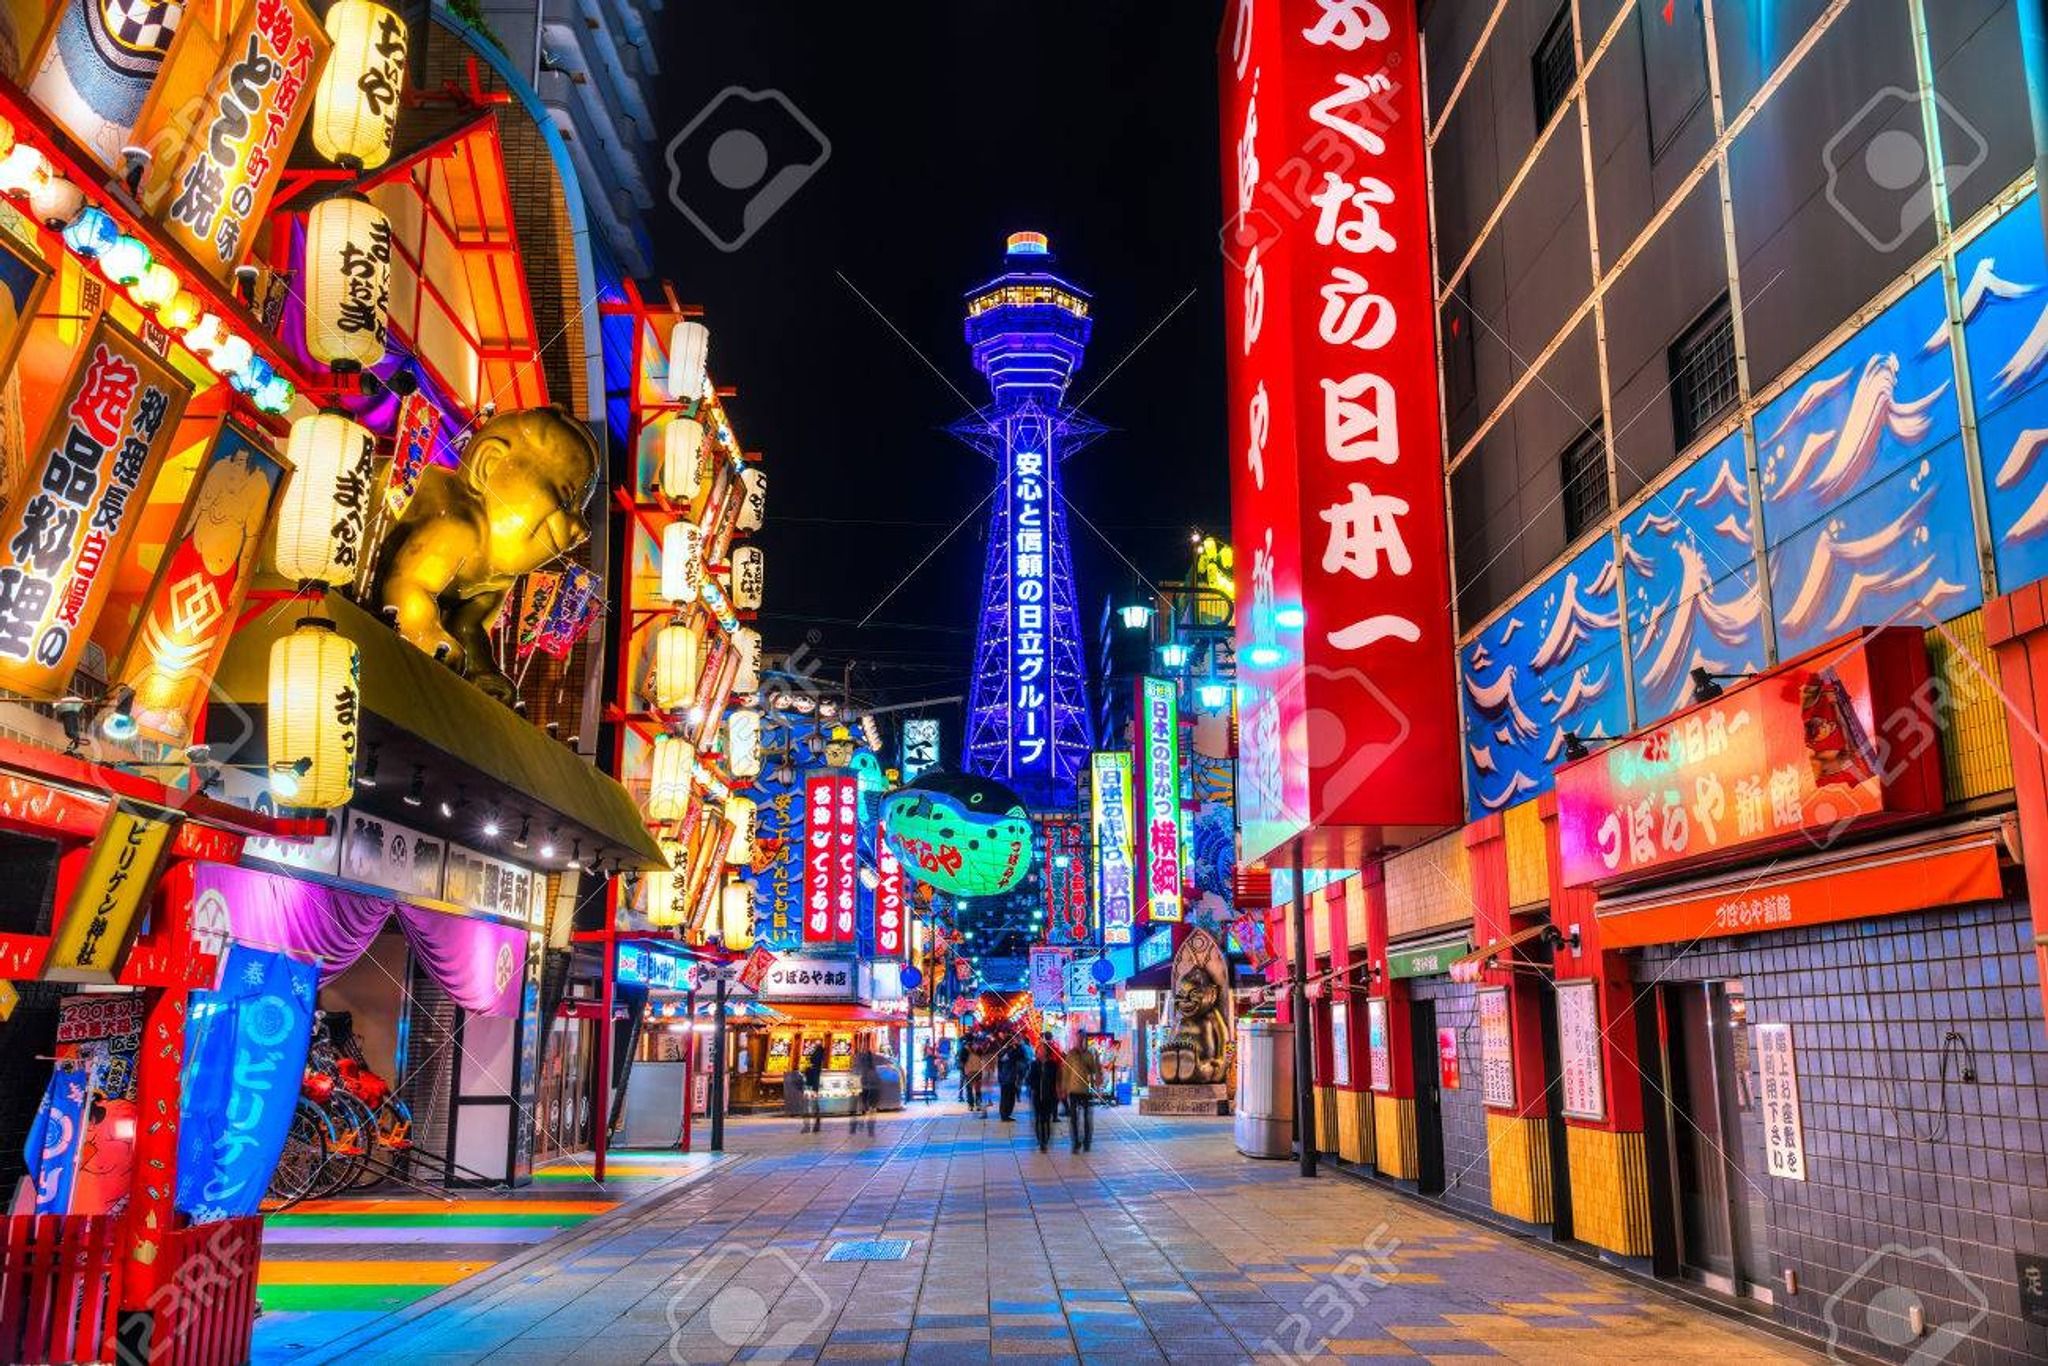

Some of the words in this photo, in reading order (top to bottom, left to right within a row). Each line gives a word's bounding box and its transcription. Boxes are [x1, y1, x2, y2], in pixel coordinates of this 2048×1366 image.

[217, 37, 314, 262] 大阪下町の味
[0, 343, 140, 660] 逸品料理
[36, 384, 168, 667] 料理長自慢の
[1015, 453, 1046, 764] 安心と信頼の日立グループ
[1152, 700, 1173, 816] 日本一の串かつ
[1150, 818, 1178, 897] 横綱
[1597, 763, 1803, 871] づぼらや新館
[1715, 894, 1793, 929] づぼらや新館
[771, 969, 847, 987] づぼらや本店
